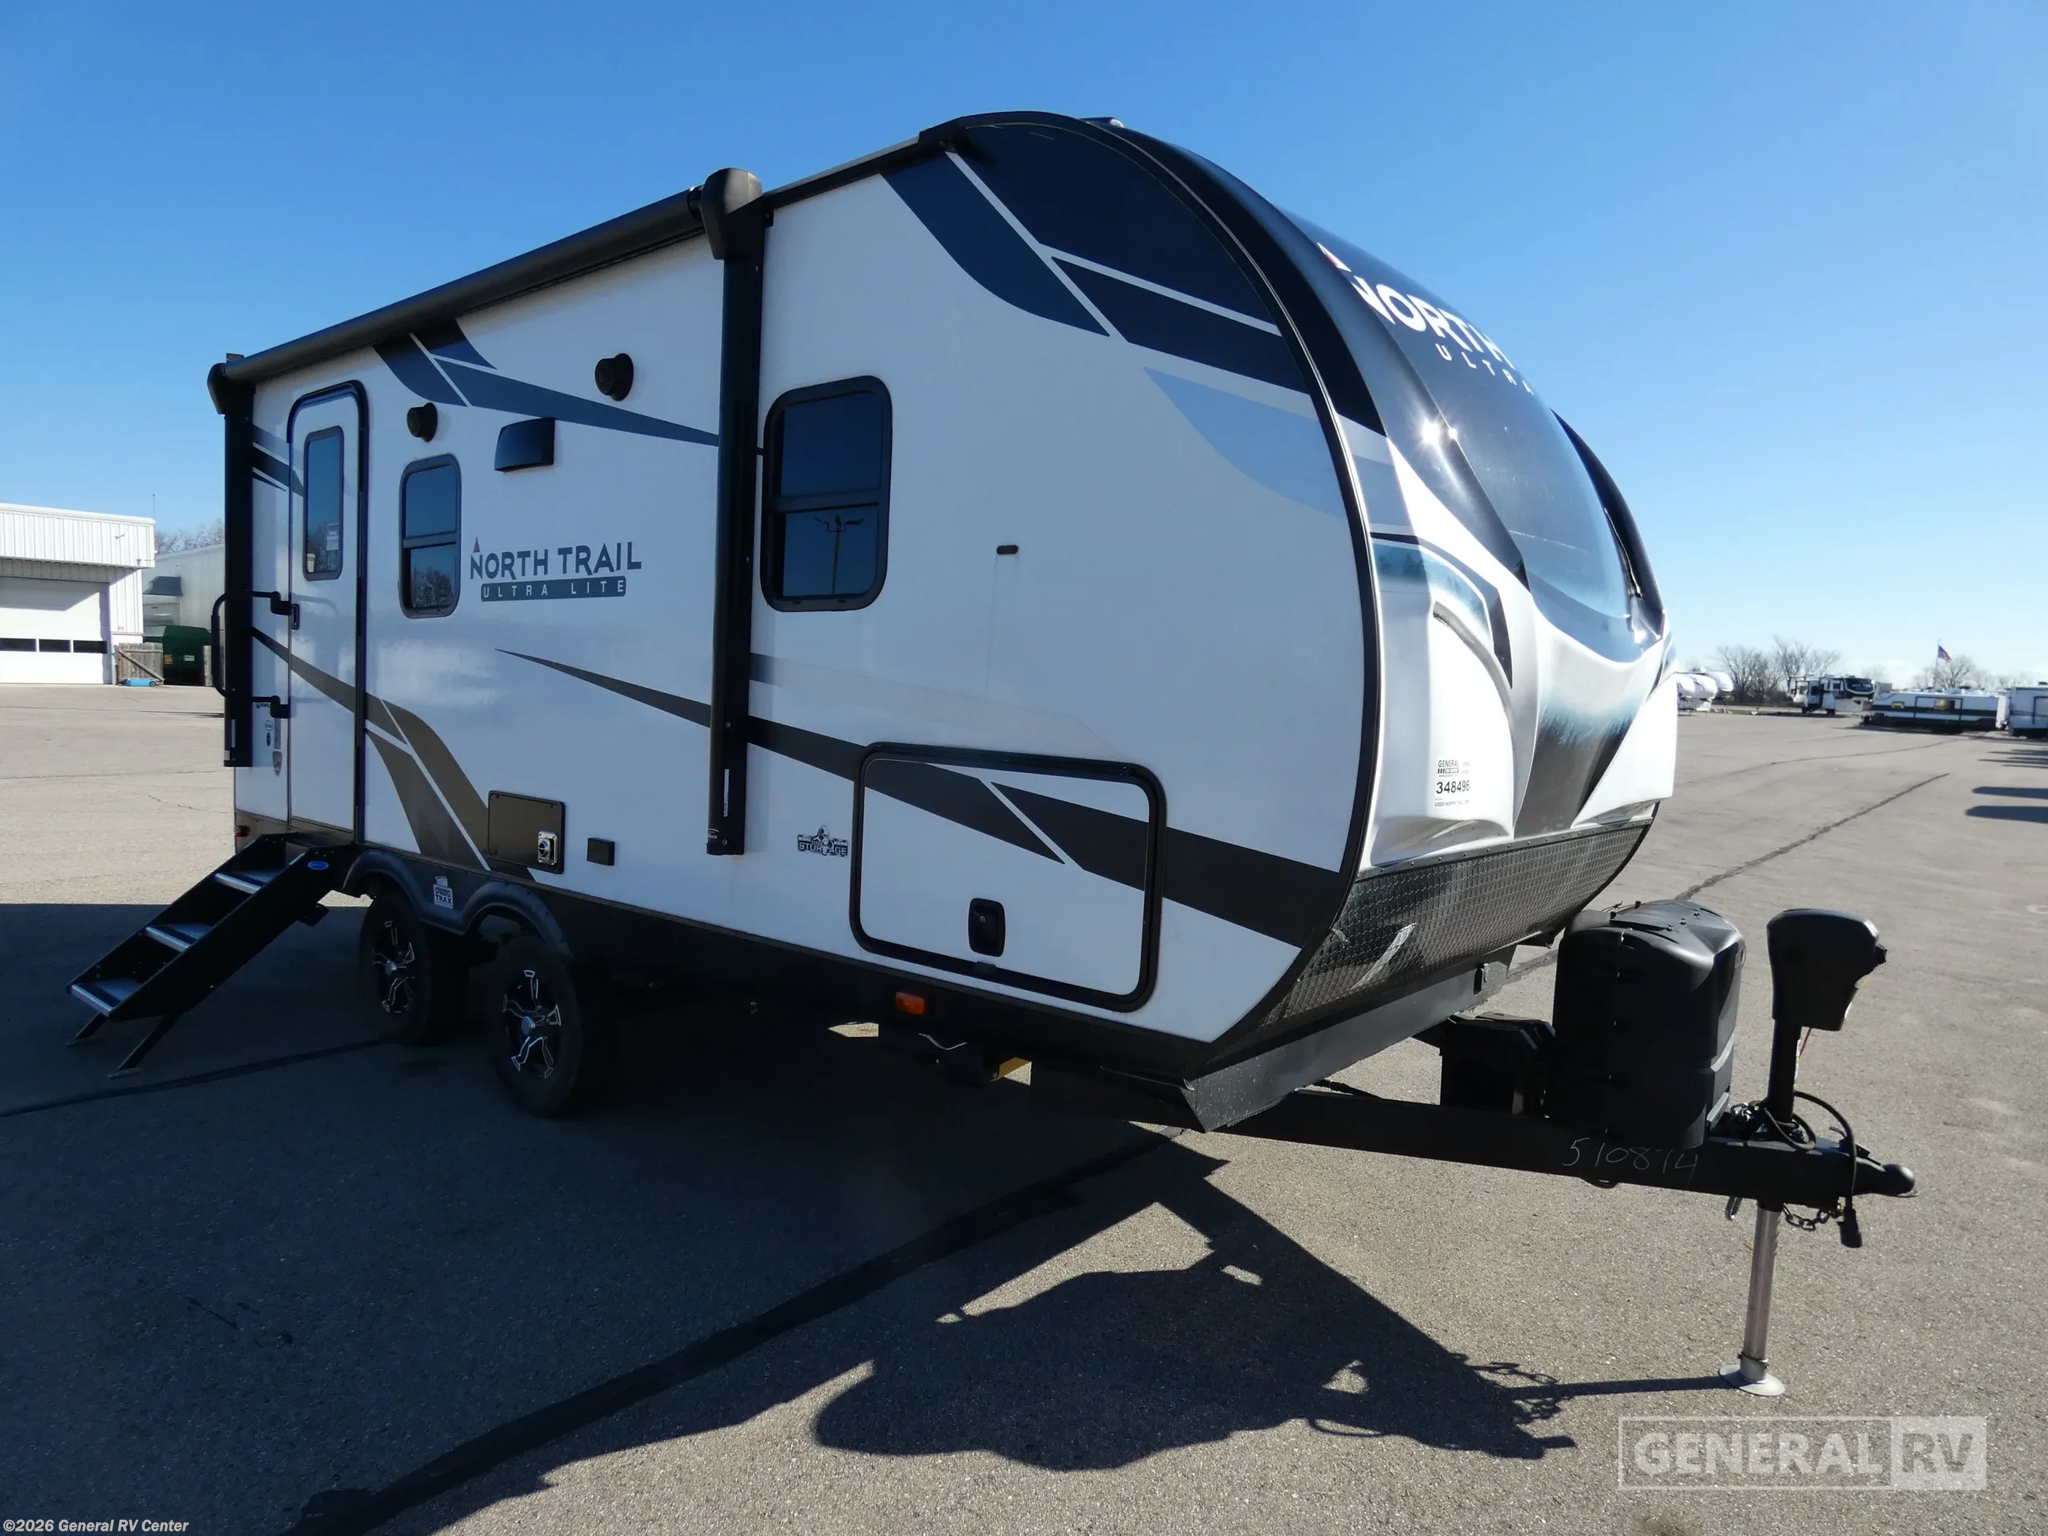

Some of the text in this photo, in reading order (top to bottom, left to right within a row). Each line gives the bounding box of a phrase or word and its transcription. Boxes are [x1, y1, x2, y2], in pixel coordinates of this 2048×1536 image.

[1351, 275, 1516, 371] NORTH
[470, 541, 642, 580] NORTH TRAIL
[483, 579, 624, 598] ULTRA LITE
[1435, 779, 1470, 794] 348496
